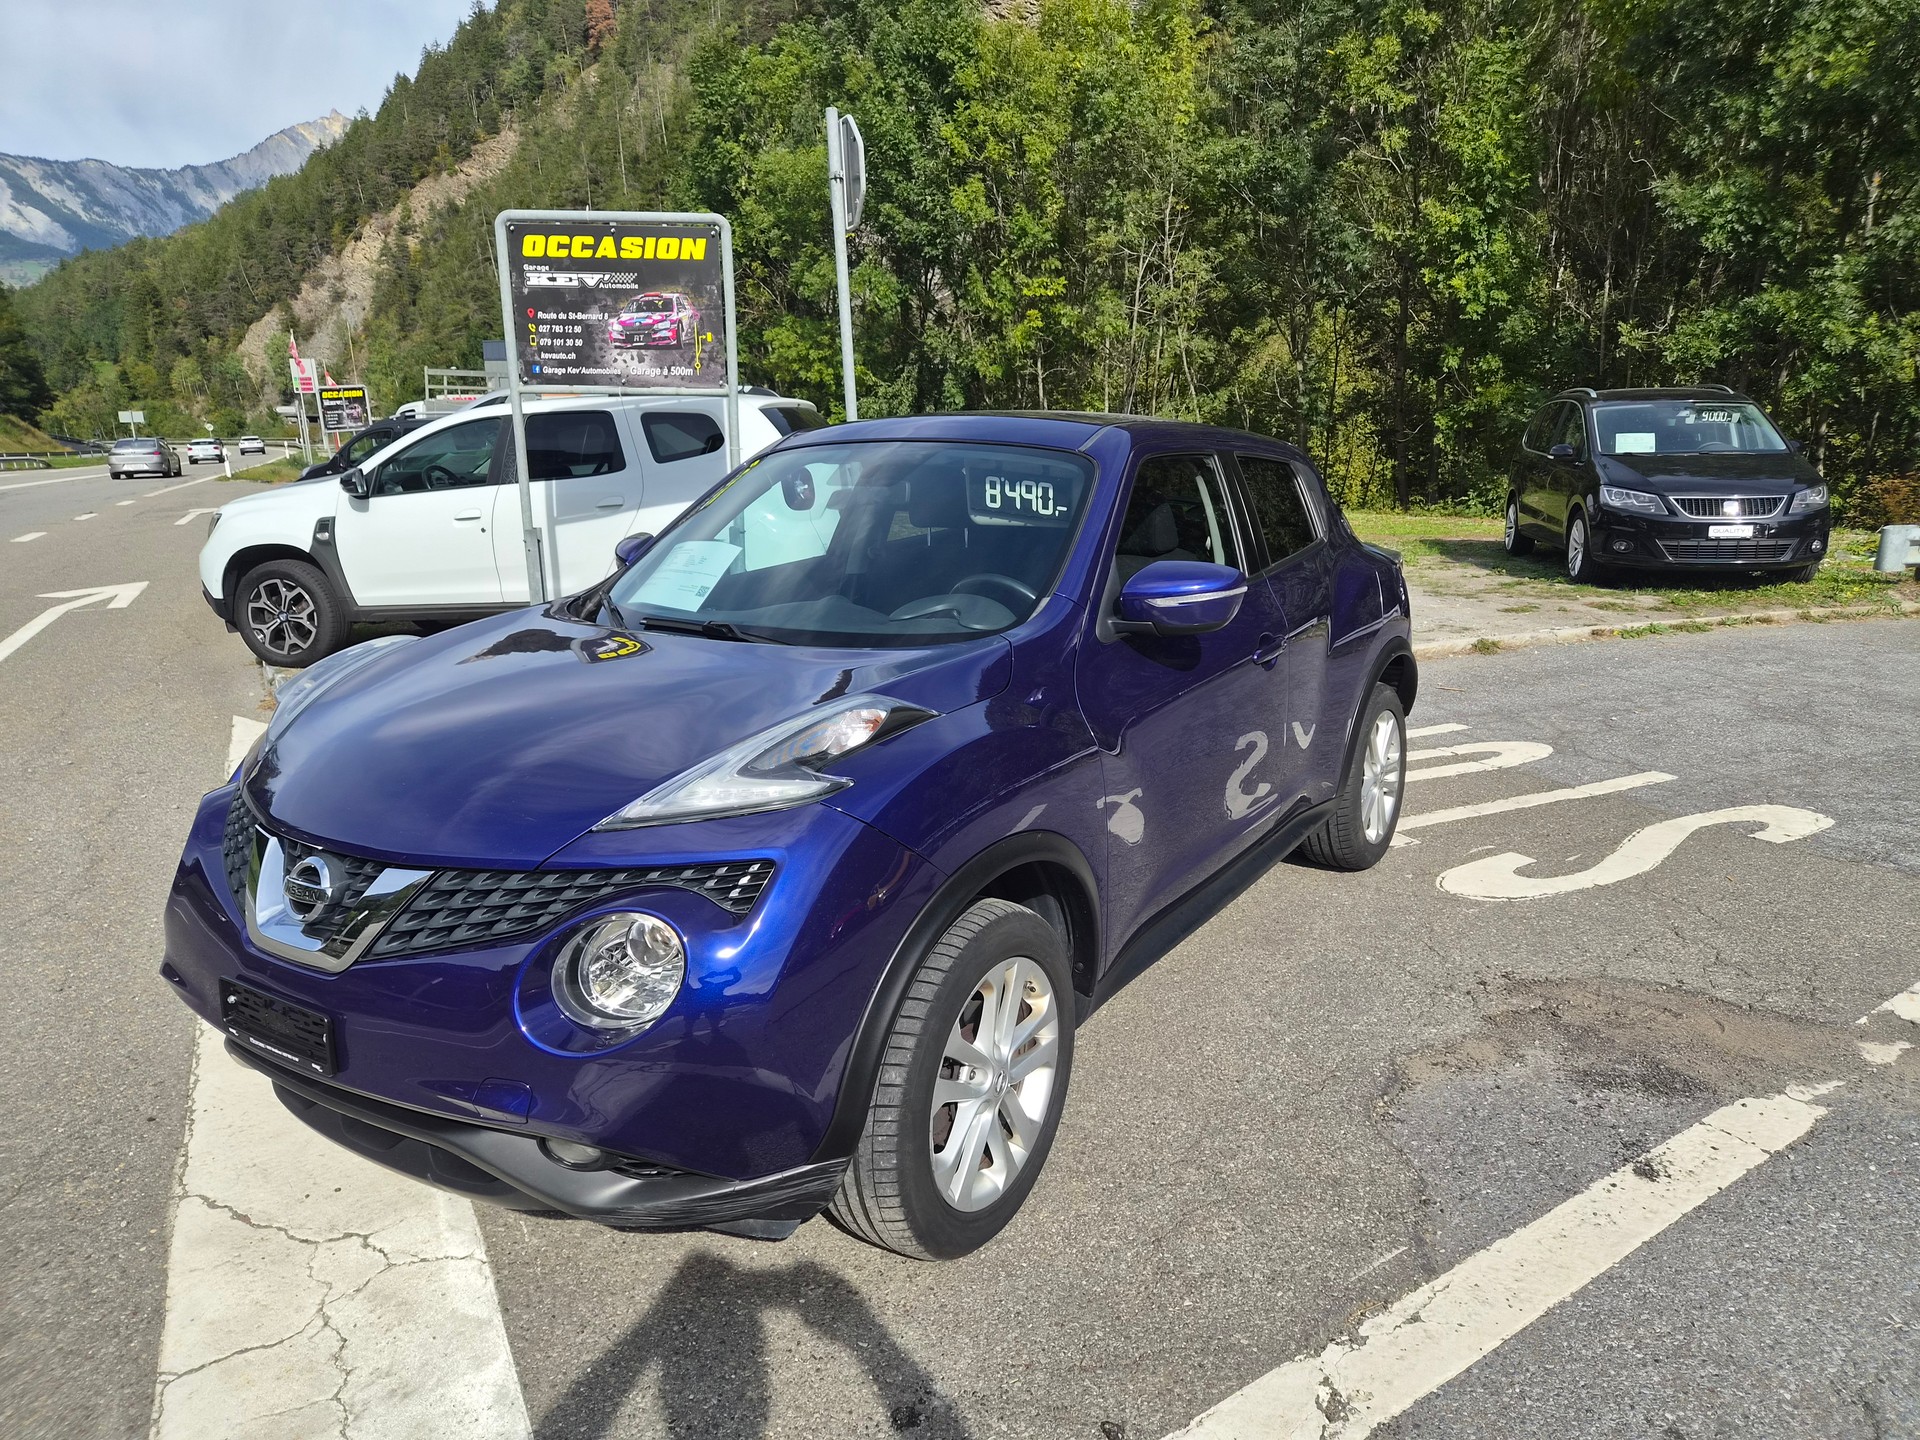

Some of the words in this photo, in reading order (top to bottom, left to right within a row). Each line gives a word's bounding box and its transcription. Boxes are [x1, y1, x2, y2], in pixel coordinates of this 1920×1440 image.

[522, 235, 707, 260] OCCASION
[523, 264, 550, 272] Garage
[537, 311, 557, 319] Route
[568, 312, 603, 320] St-Bernard
[538, 325, 550, 333] 027
[552, 325, 563, 333] 783
[565, 325, 573, 333] 12
[573, 325, 582, 333] 50
[540, 338, 552, 346] 079
[553, 338, 564, 346] 101
[565, 338, 574, 346] 30
[574, 338, 583, 346] 50
[540, 351, 577, 360] kevauto.ch
[542, 366, 566, 375] Garage
[630, 366, 661, 378] Garage
[662, 365, 668, 376] à
[670, 366, 694, 376] 500m
[322, 389, 363, 398] OCCASION
